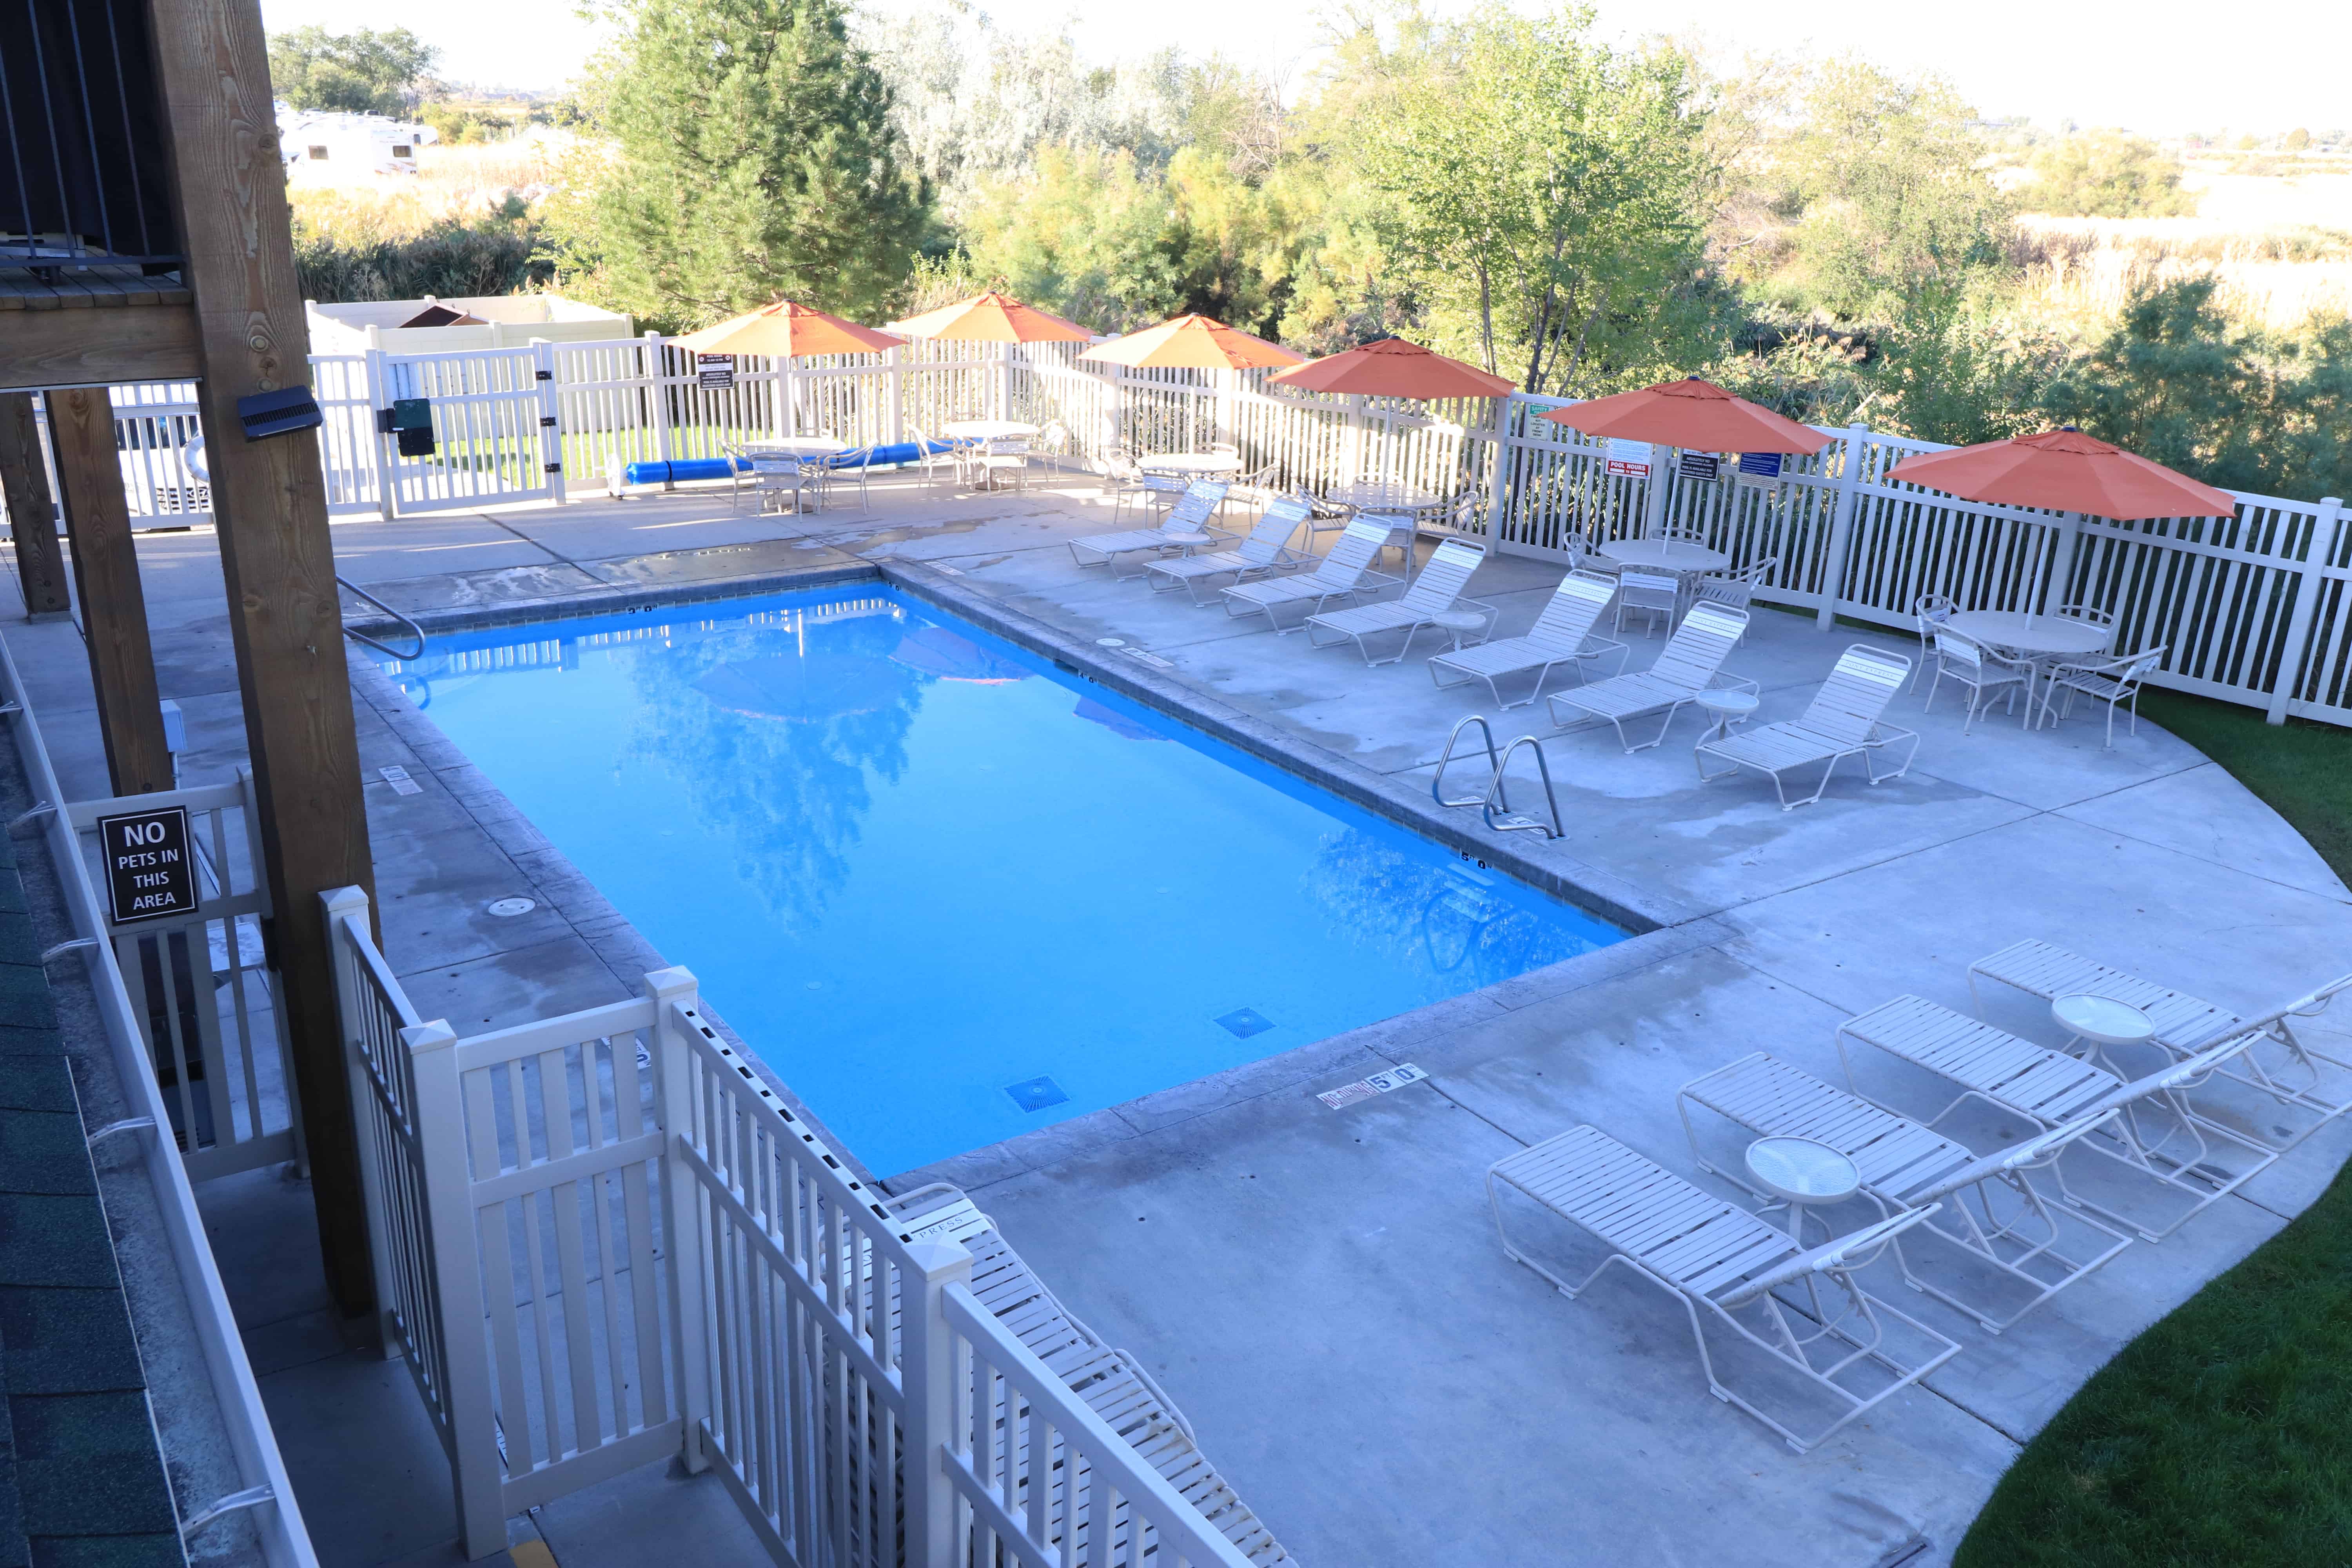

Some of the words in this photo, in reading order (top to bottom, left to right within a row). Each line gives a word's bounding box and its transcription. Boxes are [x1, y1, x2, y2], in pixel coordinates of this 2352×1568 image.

[124, 822, 165, 847] NO
[118, 852, 157, 869] PETS
[162, 849, 179, 863] IN
[1461, 851, 1469, 862] 5
[1477, 860, 1486, 869] 0
[133, 871, 169, 888] THIS
[133, 892, 176, 910] AREA
[1370, 1076, 1391, 1089] 5
[1394, 1068, 1416, 1080] 0
[913, 1217, 963, 1238] PRESS
